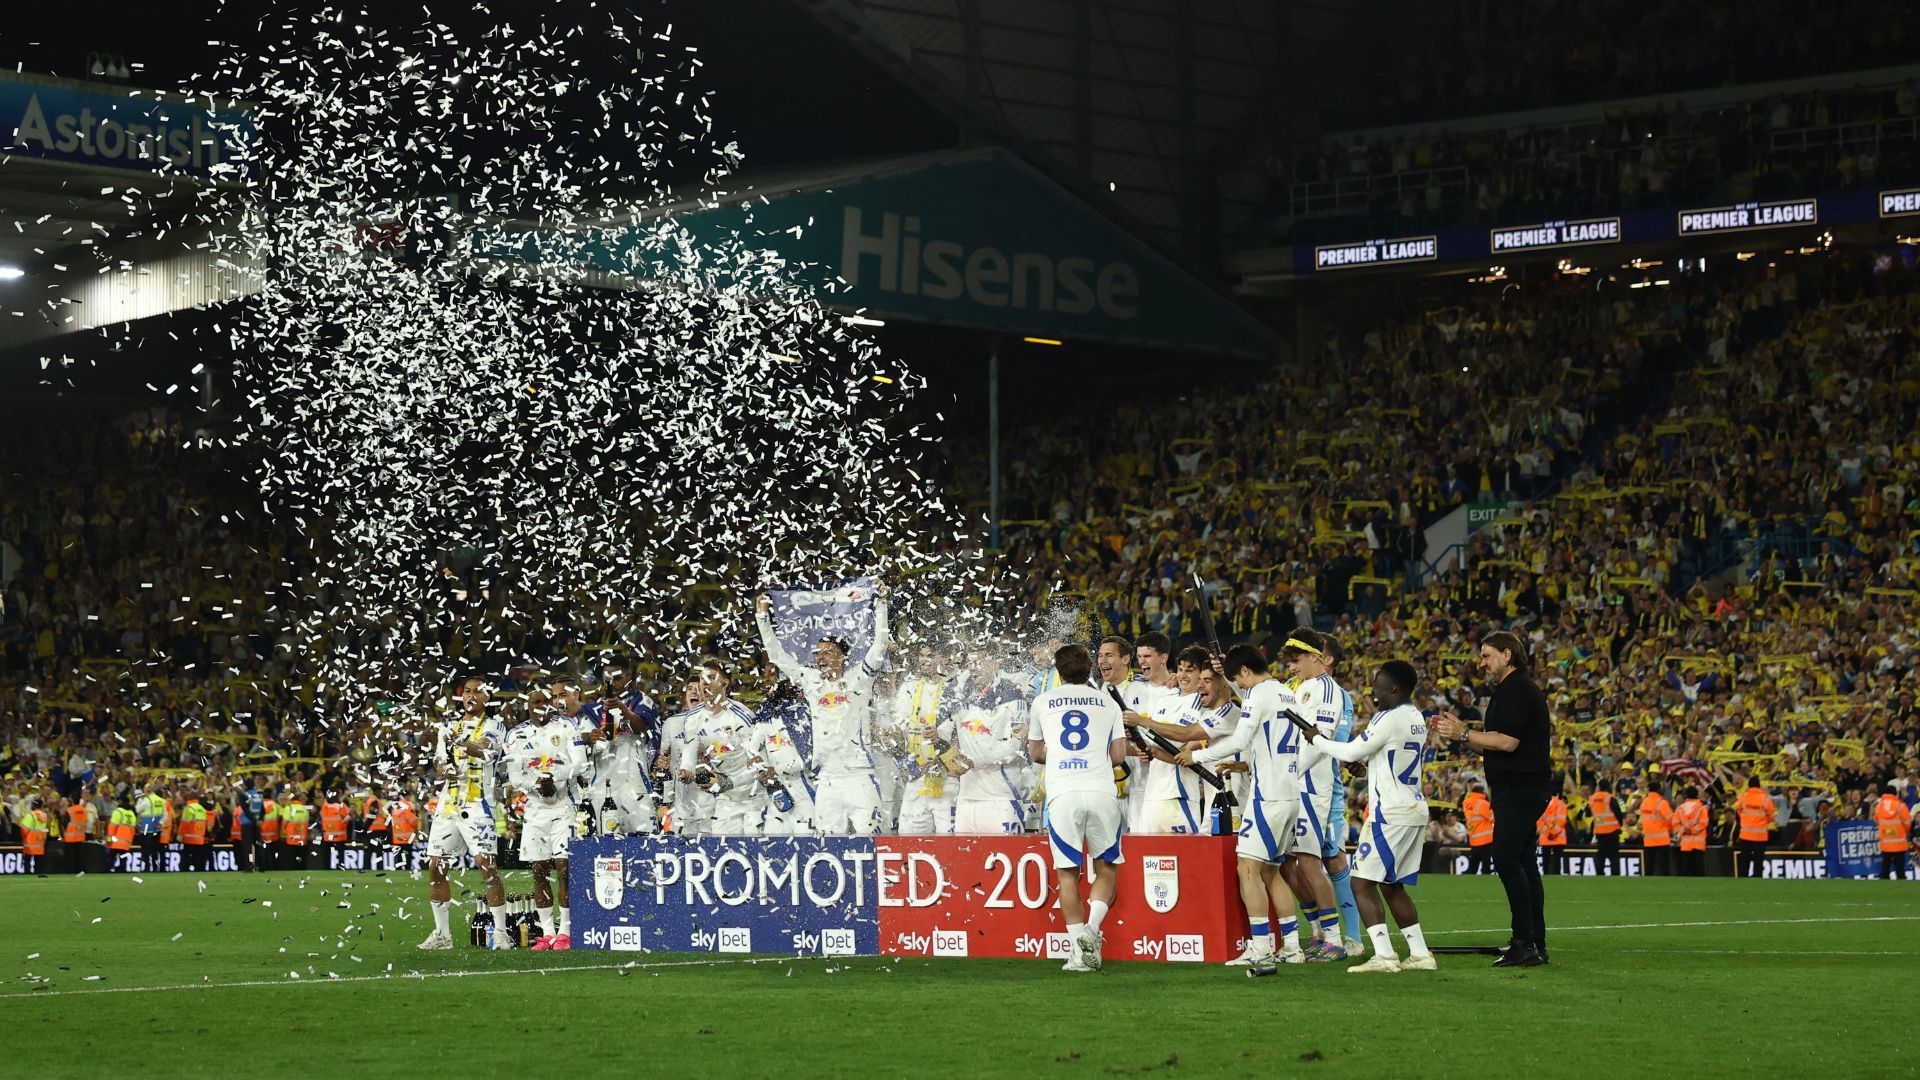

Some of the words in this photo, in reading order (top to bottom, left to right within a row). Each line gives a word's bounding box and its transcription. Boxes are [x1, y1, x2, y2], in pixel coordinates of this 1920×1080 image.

[13, 92, 220, 168] Astonish
[1682, 209, 1749, 231] PREMIER
[1754, 204, 1814, 225] LEAGUE
[1494, 227, 1557, 248] PREMIER
[1562, 221, 1618, 242] LEAGUE
[840, 206, 1139, 319] Hisense
[1318, 245, 1378, 266] PREMIER
[1381, 240, 1435, 260] LEAGUE
[1469, 508, 1496, 521] EXIT
[1048, 697, 1106, 709] ROTHWELL
[1316, 709, 1336, 717] BOXT
[1060, 709, 1090, 751] 8
[1277, 711, 1300, 754] 2
[1058, 757, 1089, 769] amt
[1398, 742, 1424, 785] 2
[1841, 830, 1880, 844] PREMIE
[1841, 843, 1882, 858] LEAGU
[1145, 860, 1158, 873] sky
[1160, 860, 1175, 869] bet
[655, 851, 945, 908] PROMOTED
[604, 897, 614, 905] EFL
[1156, 900, 1168, 908] EFL
[583, 926, 608, 949] sky
[613, 929, 637, 945] bet
[690, 929, 716, 951] sky
[722, 931, 747, 947] bet
[793, 930, 820, 952] sky
[825, 932, 852, 949] bet
[903, 932, 931, 954] sky
[936, 933, 964, 950] bet
[1015, 933, 1043, 957] sky
[1050, 936, 1071, 952] be
[1133, 935, 1164, 960] sky
[1170, 937, 1200, 955] bet
[1236, 936, 1249, 951] sk
